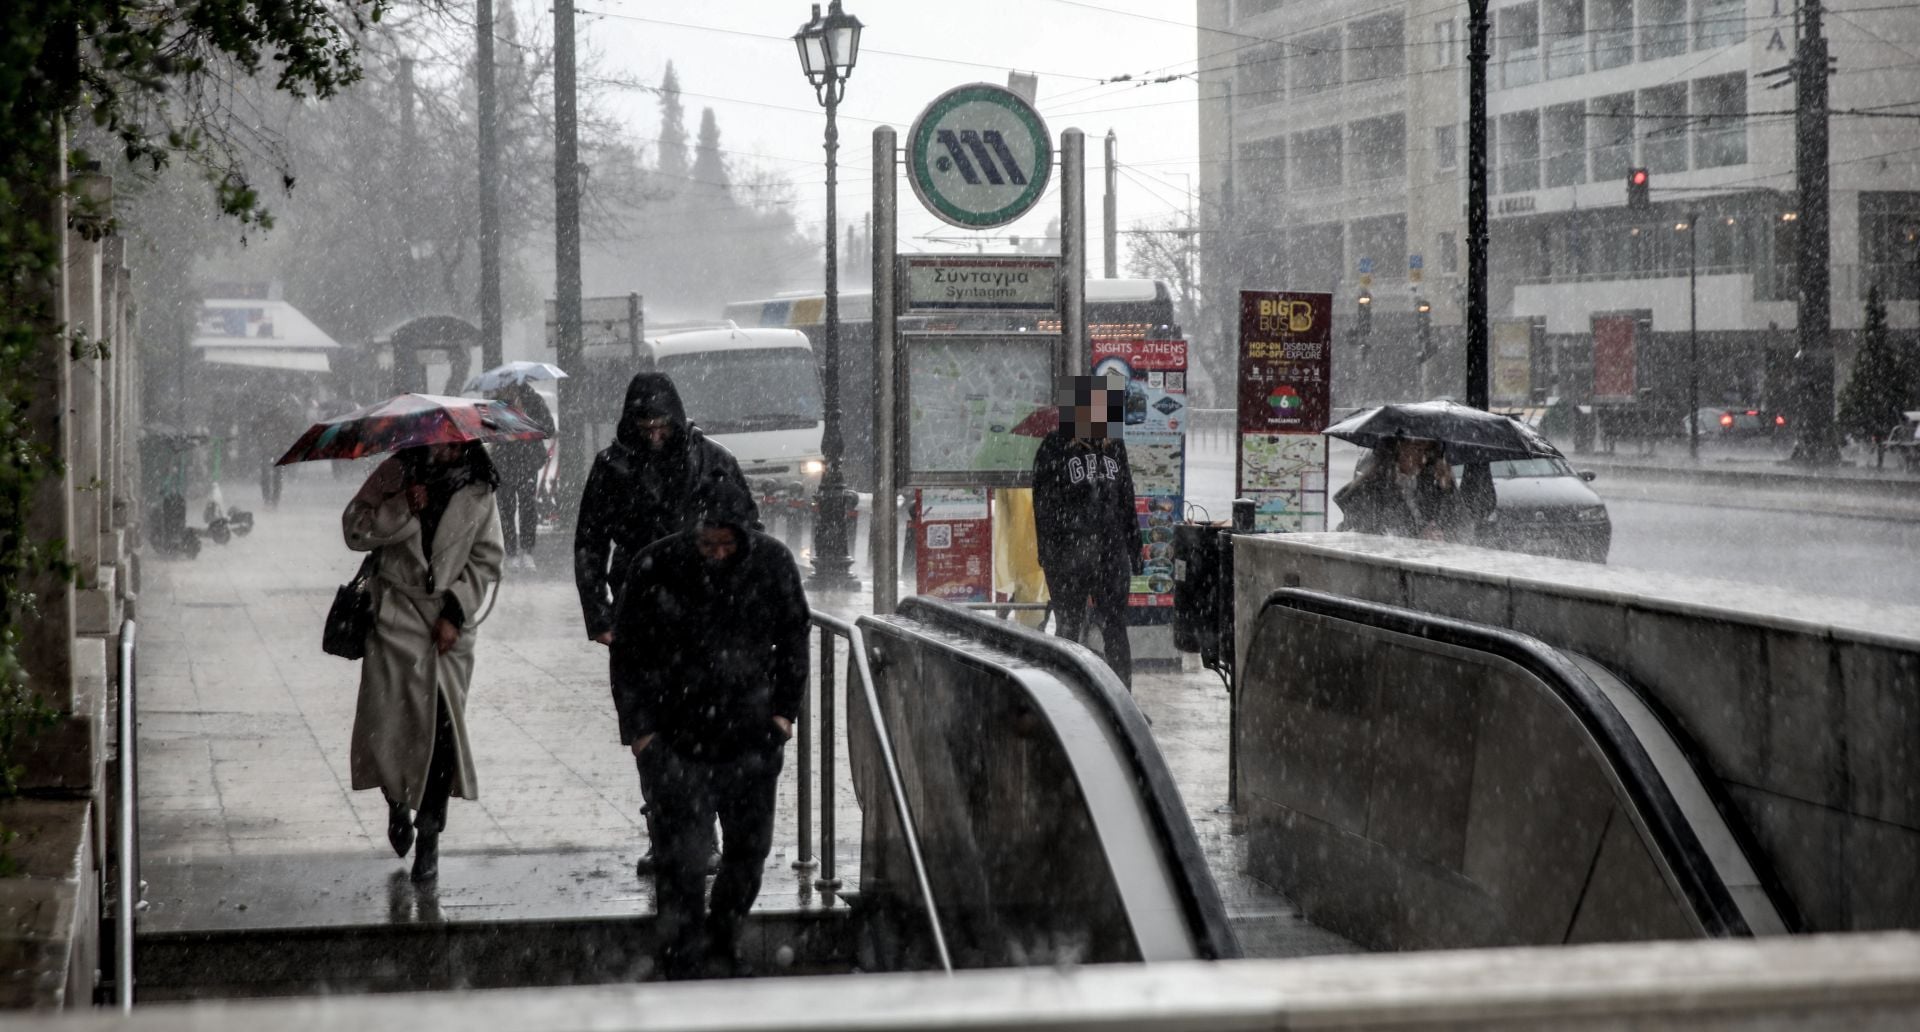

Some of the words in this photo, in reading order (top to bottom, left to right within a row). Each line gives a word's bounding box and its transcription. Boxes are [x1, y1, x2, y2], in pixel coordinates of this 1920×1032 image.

[934, 268, 1029, 286] Σύνταγμα
[946, 286, 1017, 299] Syntagma
[1260, 300, 1289, 316] BIG
[1260, 316, 1289, 331] BUS
[1095, 343, 1132, 353] SIGHTS
[1142, 343, 1185, 354] ATHENS
[1249, 342, 1281, 350] HOP-ON
[1283, 342, 1322, 351] DISCOVER
[1249, 350, 1285, 358] HOP-OFF
[1286, 351, 1322, 359] EXPLORE
[1280, 395, 1289, 408] 6
[1068, 453, 1119, 484] GAP
